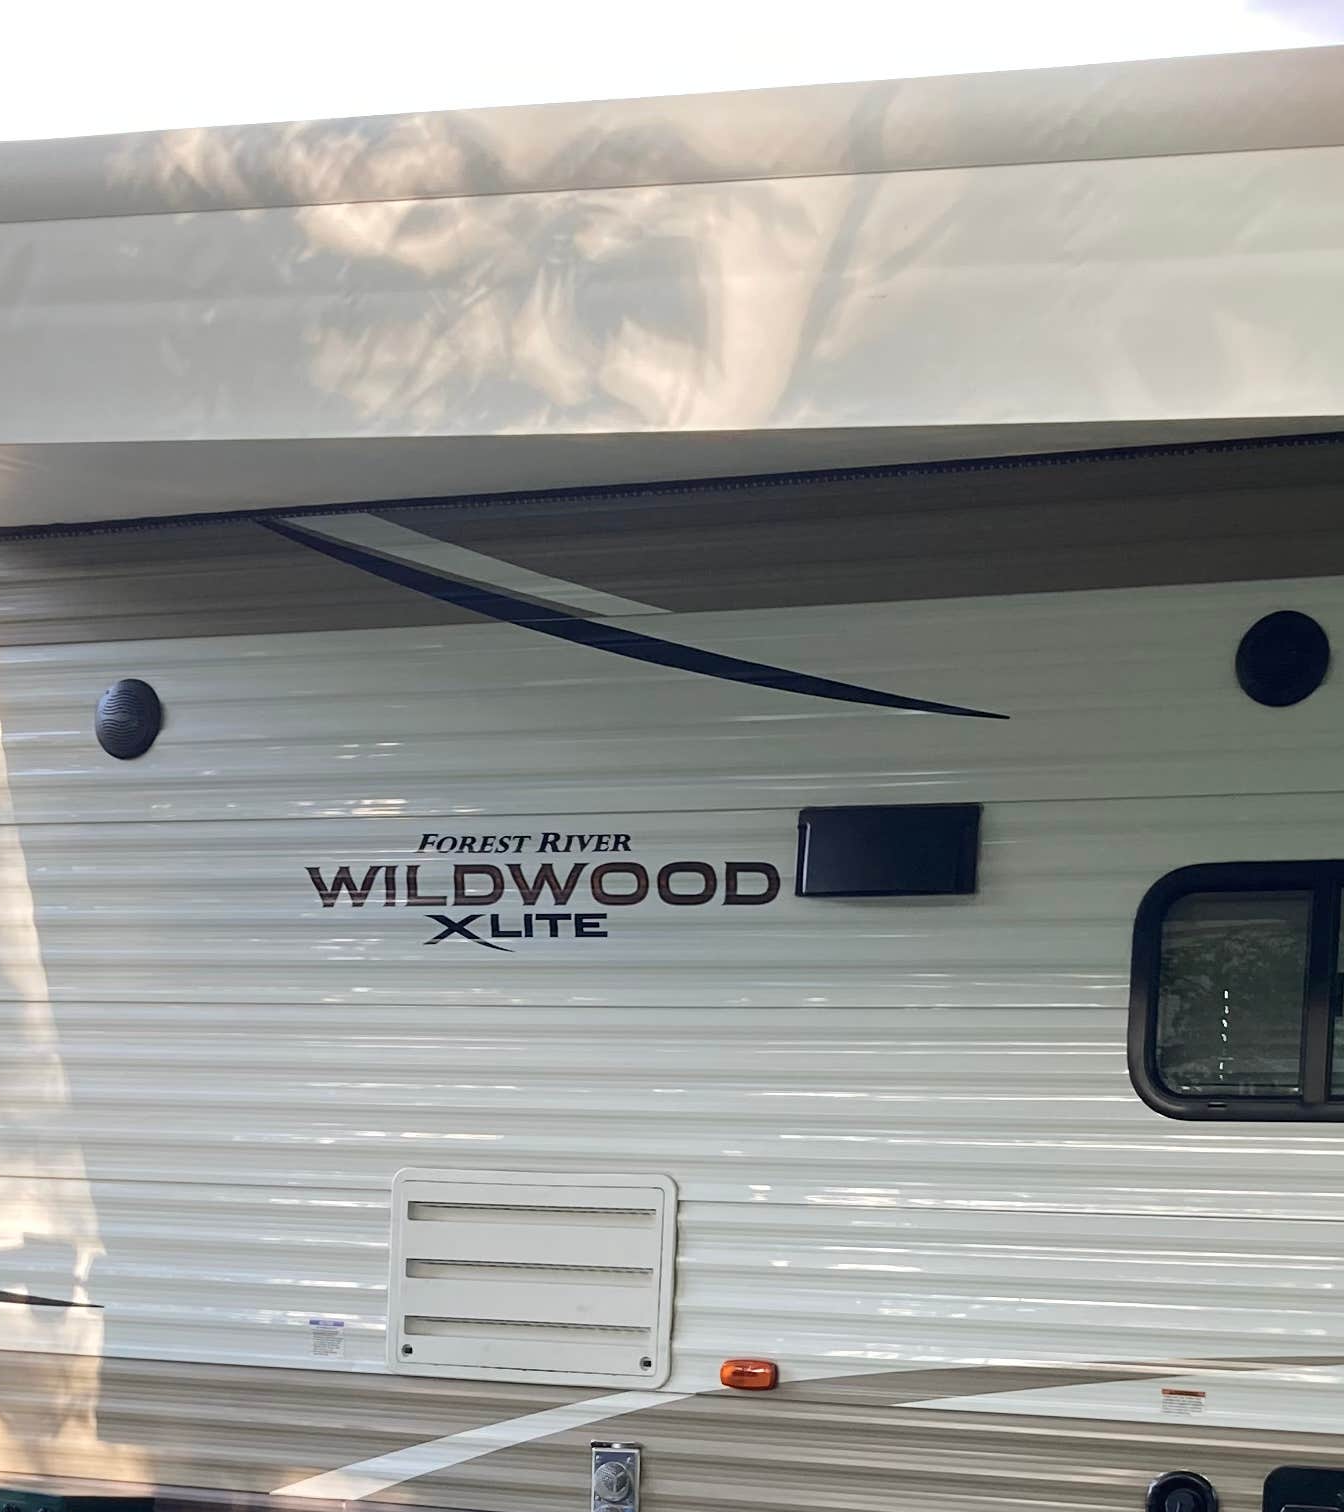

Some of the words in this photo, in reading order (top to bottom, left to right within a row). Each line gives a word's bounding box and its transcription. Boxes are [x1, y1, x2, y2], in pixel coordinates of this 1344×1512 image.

[415, 833, 531, 854] FOREST
[537, 831, 632, 853] RIVER
[304, 861, 781, 908] WILDWOOD
